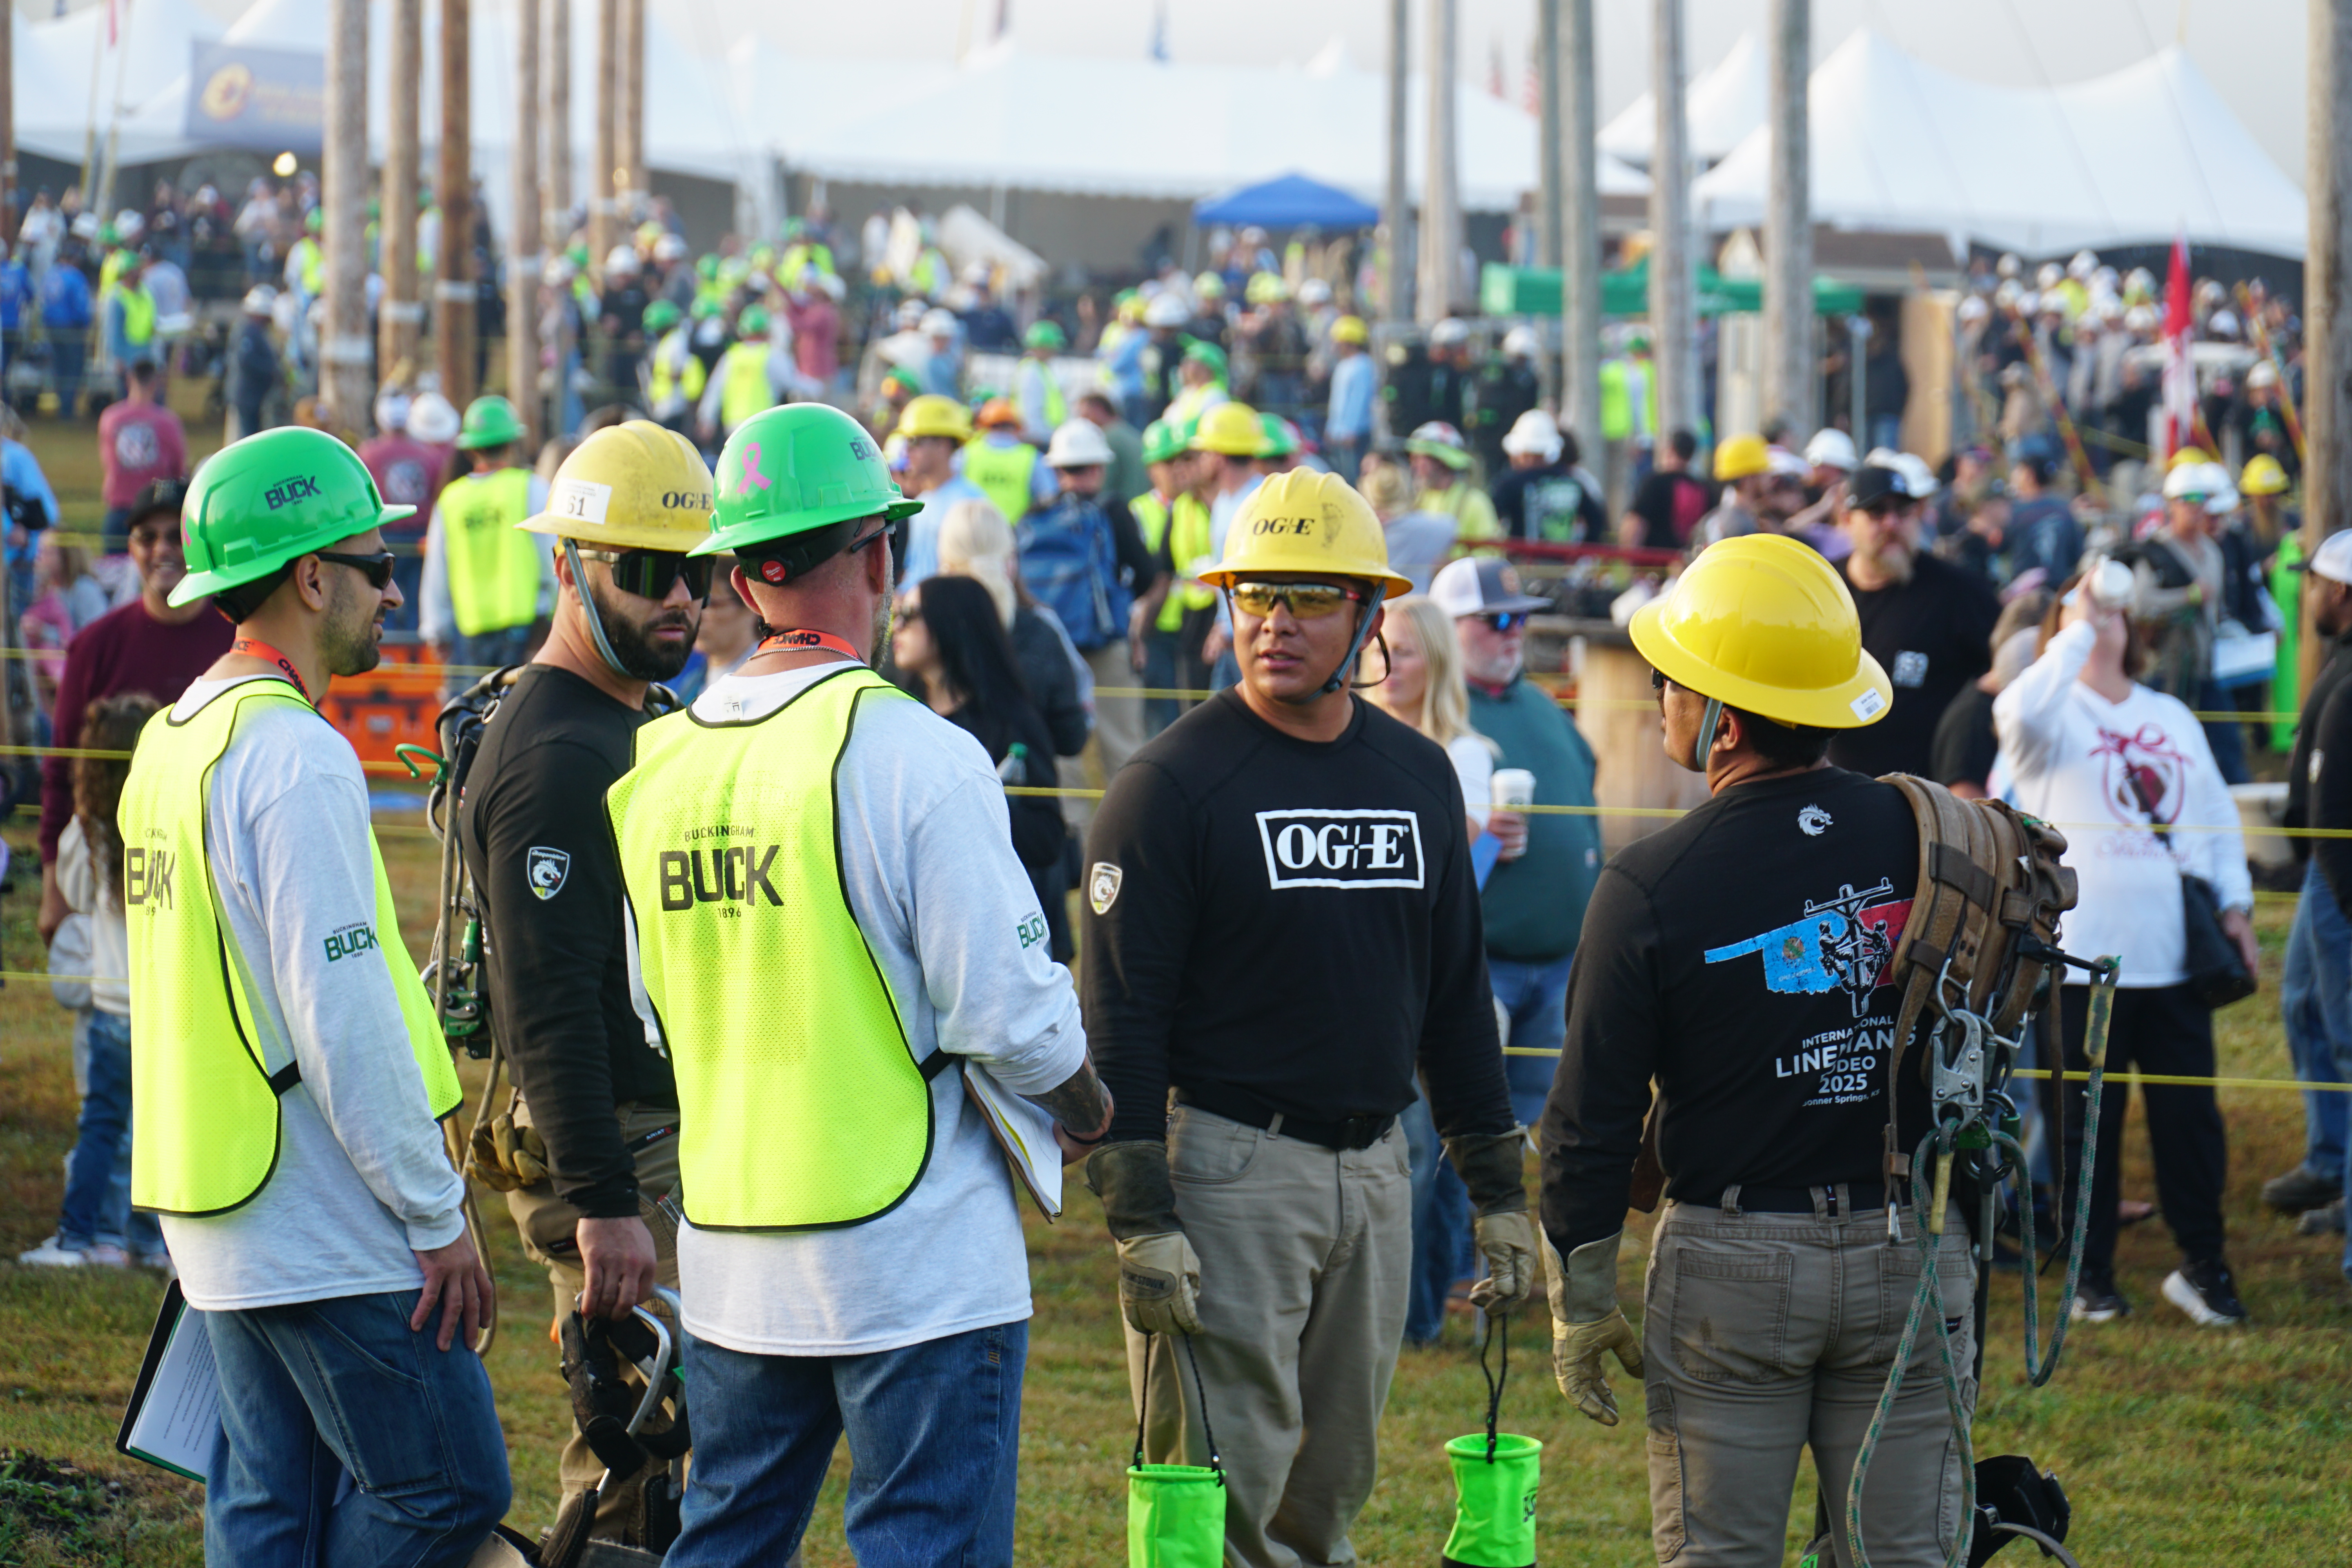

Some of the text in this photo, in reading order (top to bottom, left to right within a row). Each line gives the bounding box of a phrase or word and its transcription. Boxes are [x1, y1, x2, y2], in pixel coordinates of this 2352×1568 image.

[265, 475, 322, 510] BUCK
[568, 495, 585, 516] 61
[684, 825, 754, 841] BUCKINGHAM
[660, 845, 784, 911] BUCK
[718, 907, 742, 918] 1896
[333, 921, 367, 935] BUCKINGHAM
[1016, 913, 1047, 950] BUCK
[323, 926, 379, 962] BUCK
[1818, 1073, 1868, 1094] 2025
[1835, 1094, 1869, 1104] Springs,
